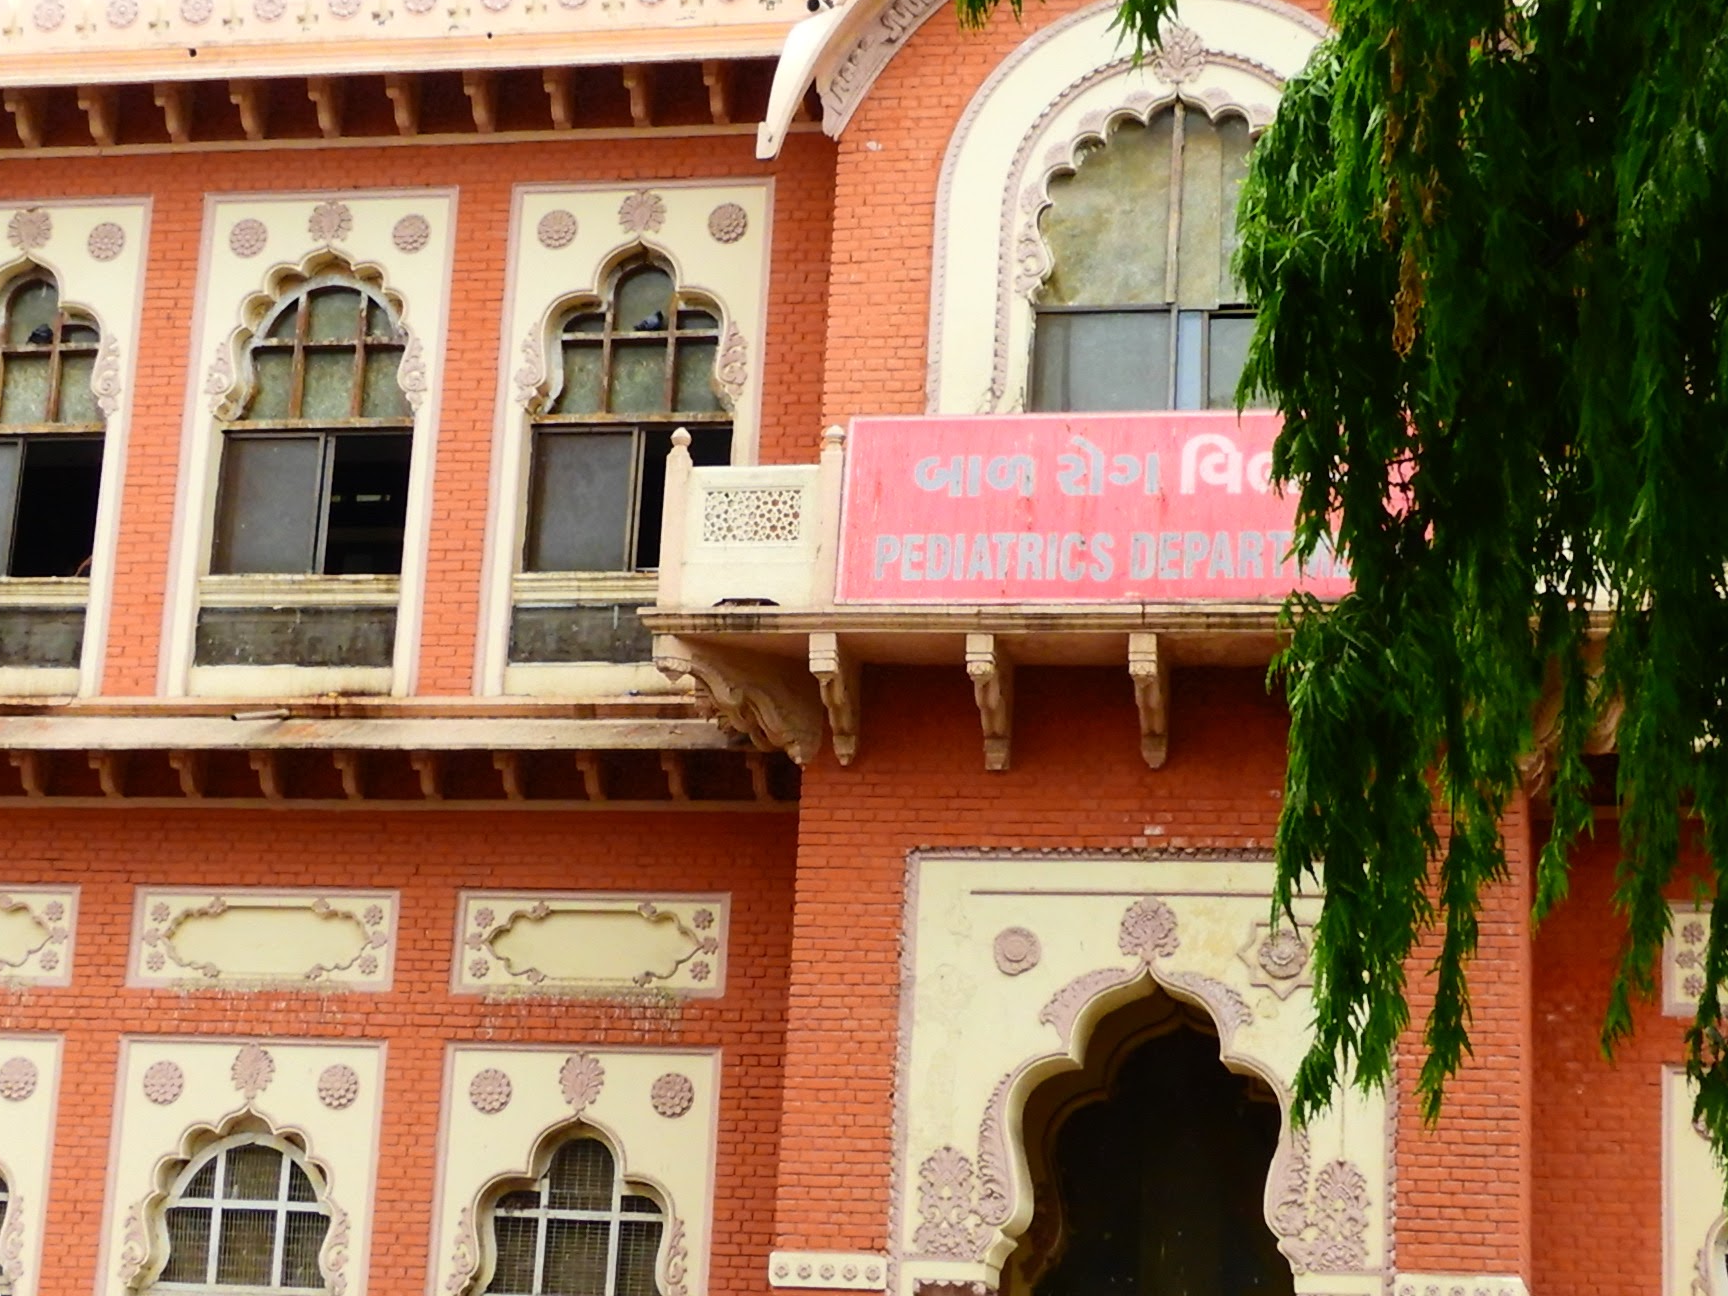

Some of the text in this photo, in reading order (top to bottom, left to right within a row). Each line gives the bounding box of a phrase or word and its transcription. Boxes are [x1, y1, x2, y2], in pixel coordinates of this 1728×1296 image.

[914, 455, 1035, 497] બાળ
[1057, 435, 1161, 496] રોગ
[874, 531, 1115, 583] PEDIATRICS
